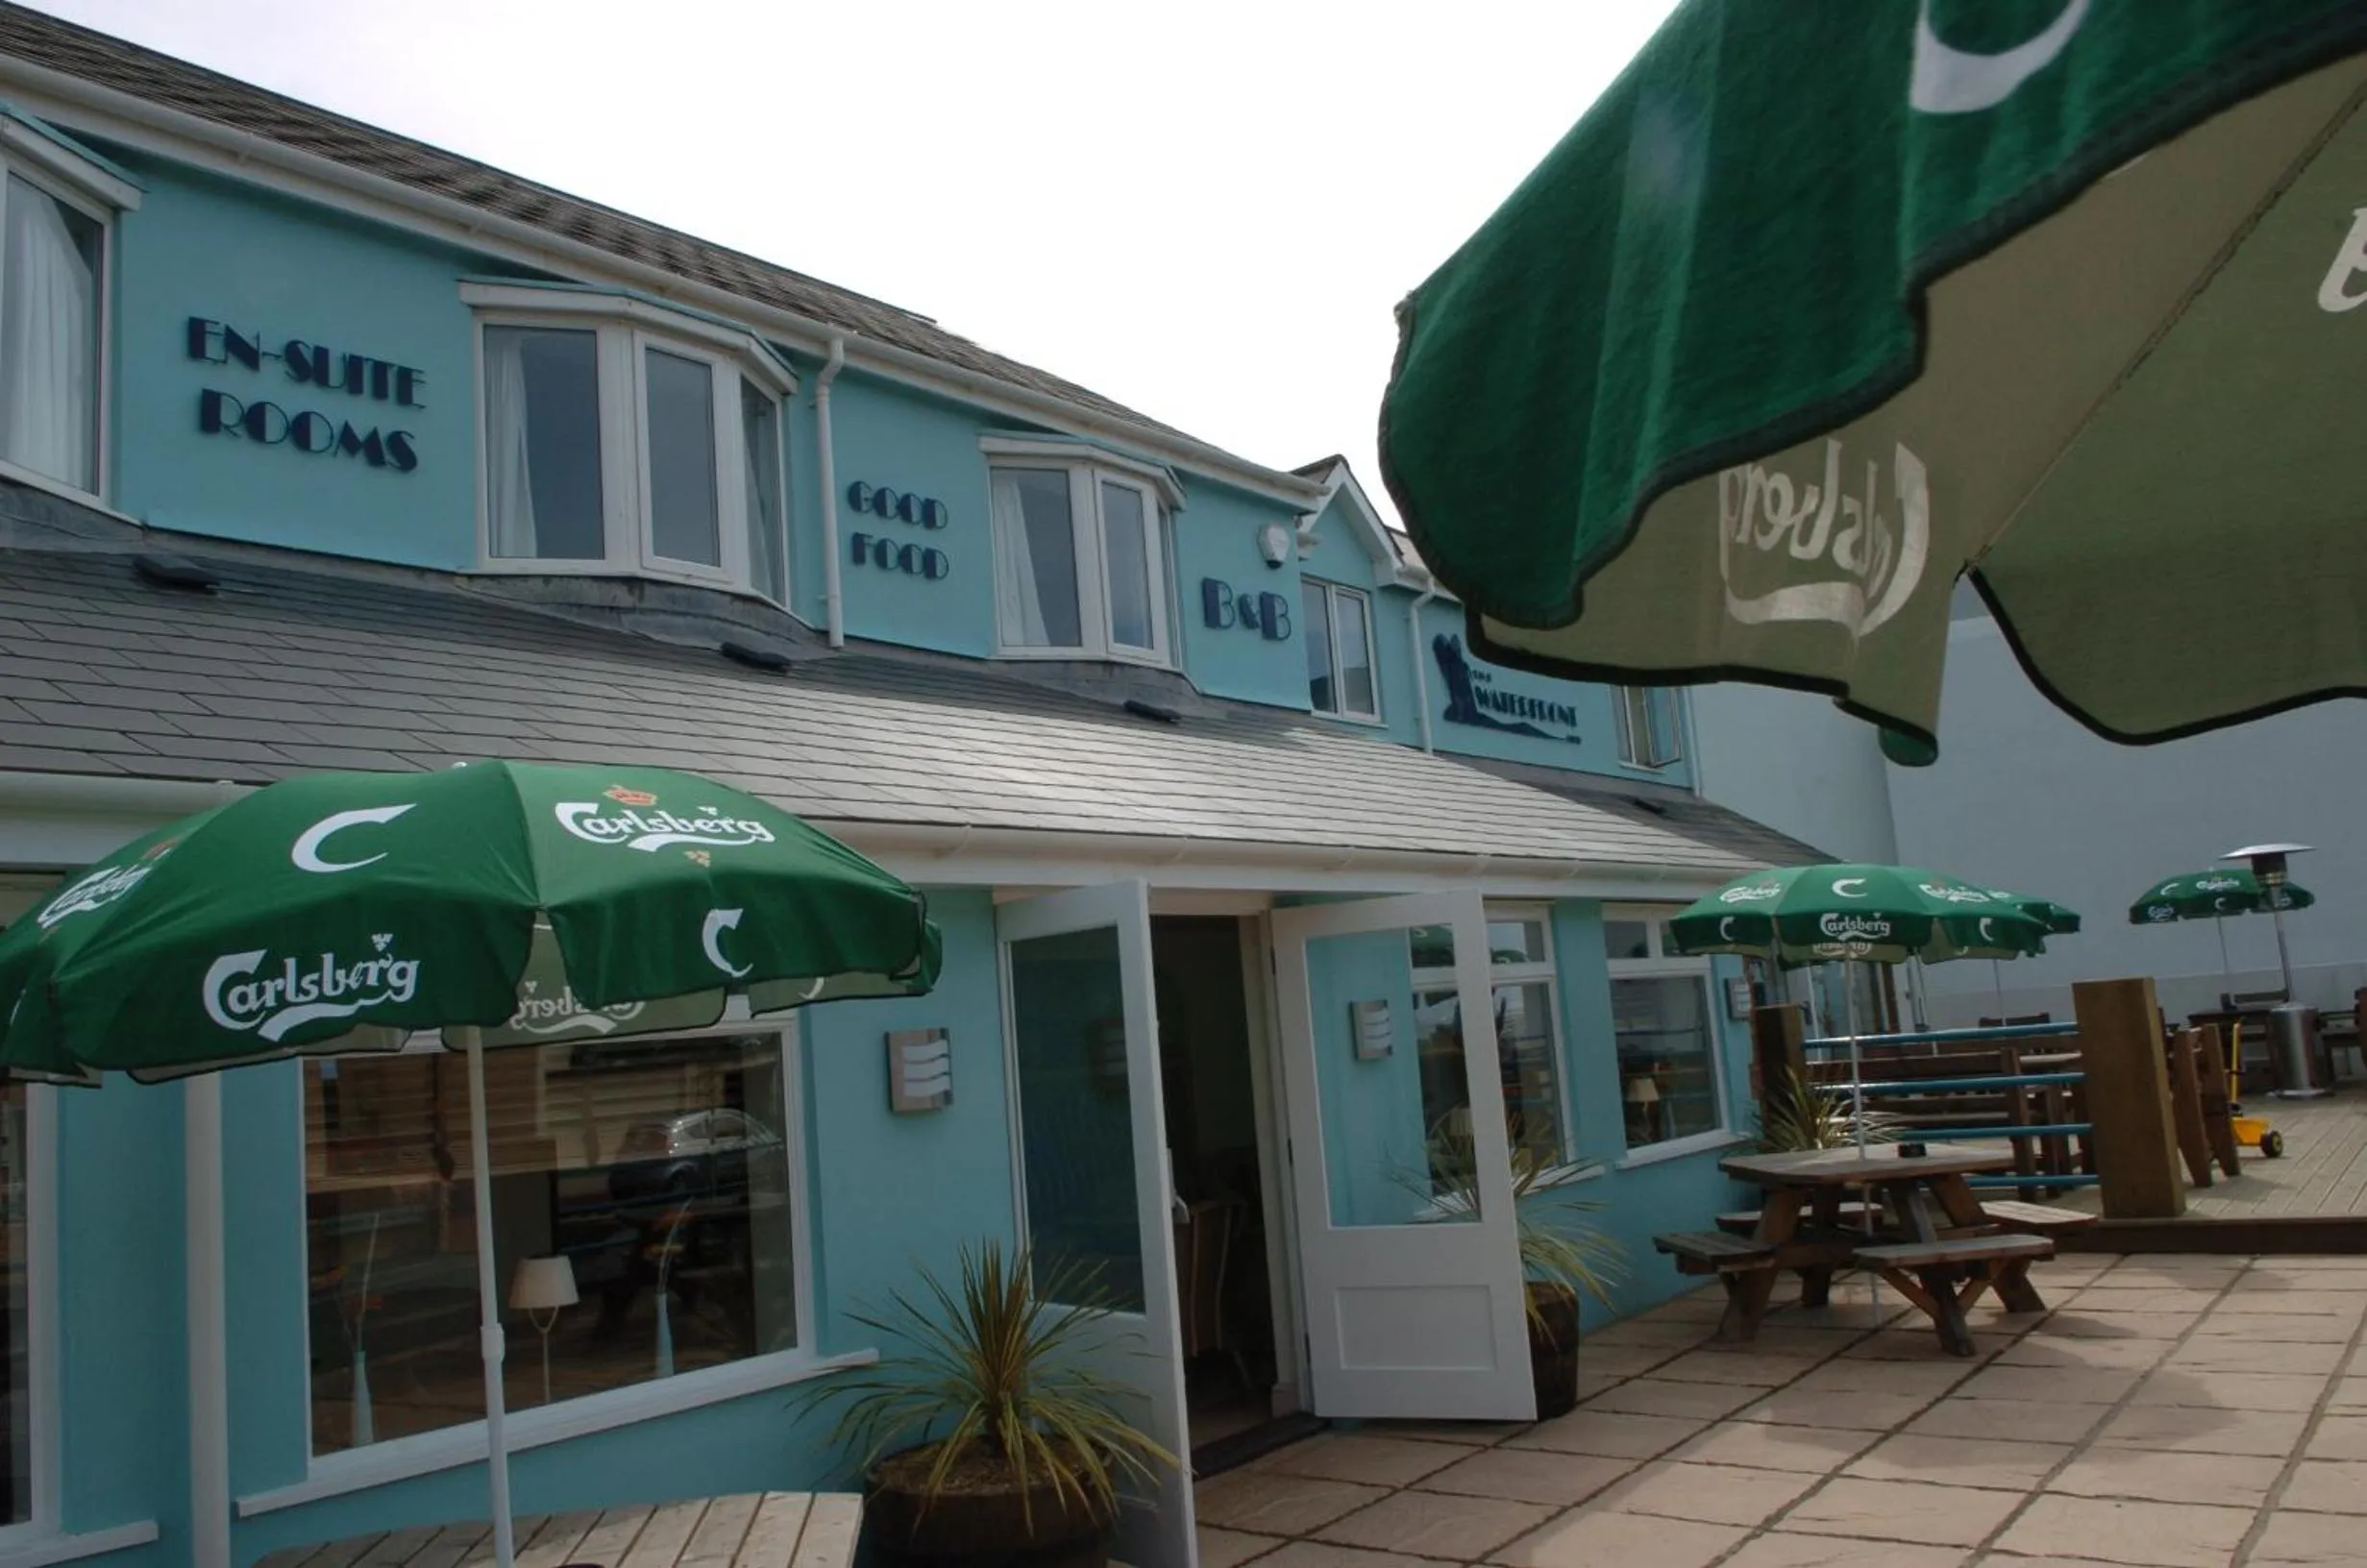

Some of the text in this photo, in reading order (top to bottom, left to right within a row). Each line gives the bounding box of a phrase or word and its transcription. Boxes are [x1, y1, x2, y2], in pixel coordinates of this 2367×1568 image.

[188, 316, 427, 409] EN-SUITE
[200, 387, 418, 472] ROOMS
[848, 480, 949, 530] GOOD
[851, 532, 949, 580] FOOD
[1201, 577, 1292, 641] B&B
[555, 801, 776, 852] Carlsberg
[1820, 912, 1891, 942] Carlsberg
[203, 949, 420, 1042] Carlsberg
